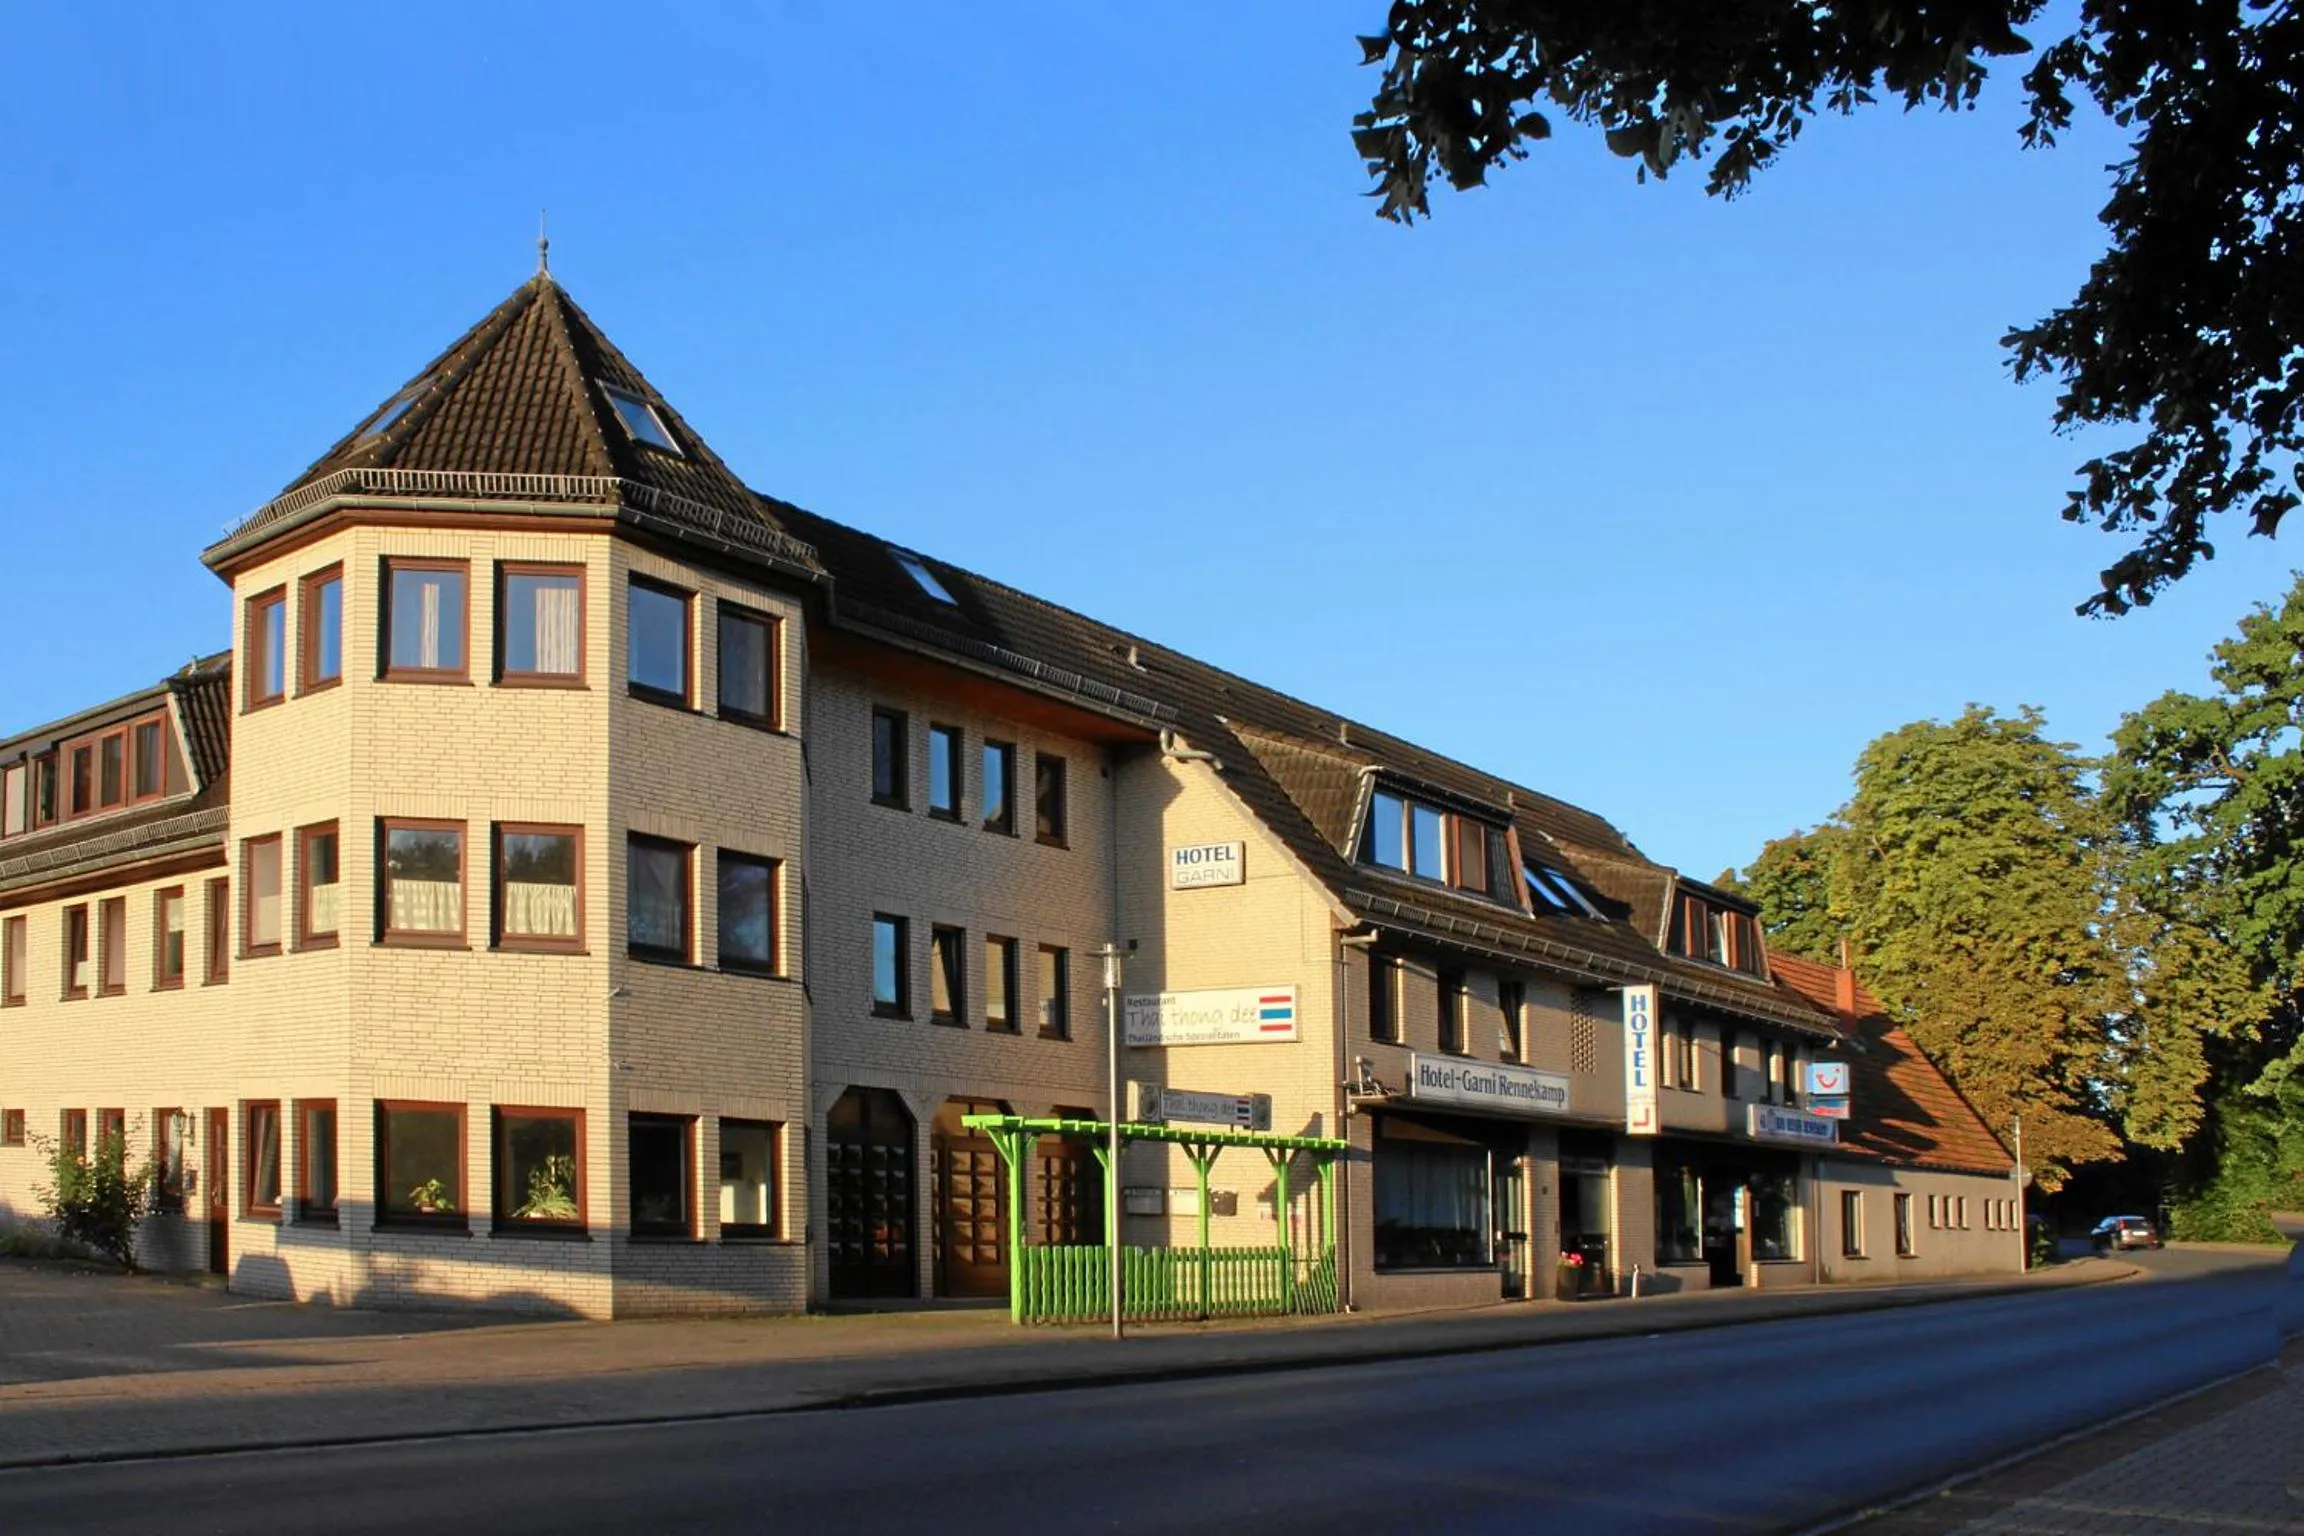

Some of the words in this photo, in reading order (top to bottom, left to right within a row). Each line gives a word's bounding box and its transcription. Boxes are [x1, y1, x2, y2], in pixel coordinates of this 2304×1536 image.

[1176, 846, 1236, 865] HOTEL
[1176, 867, 1234, 884] GARNI
[1127, 996, 1176, 1007] Restaurant
[1168, 1005, 1223, 1032] thong
[1230, 1000, 1257, 1025] dee
[1630, 994, 1648, 1087] HOTEL
[1420, 1064, 1496, 1095] Hotel-Garni
[1499, 1075, 1565, 1107] Rennekamp
